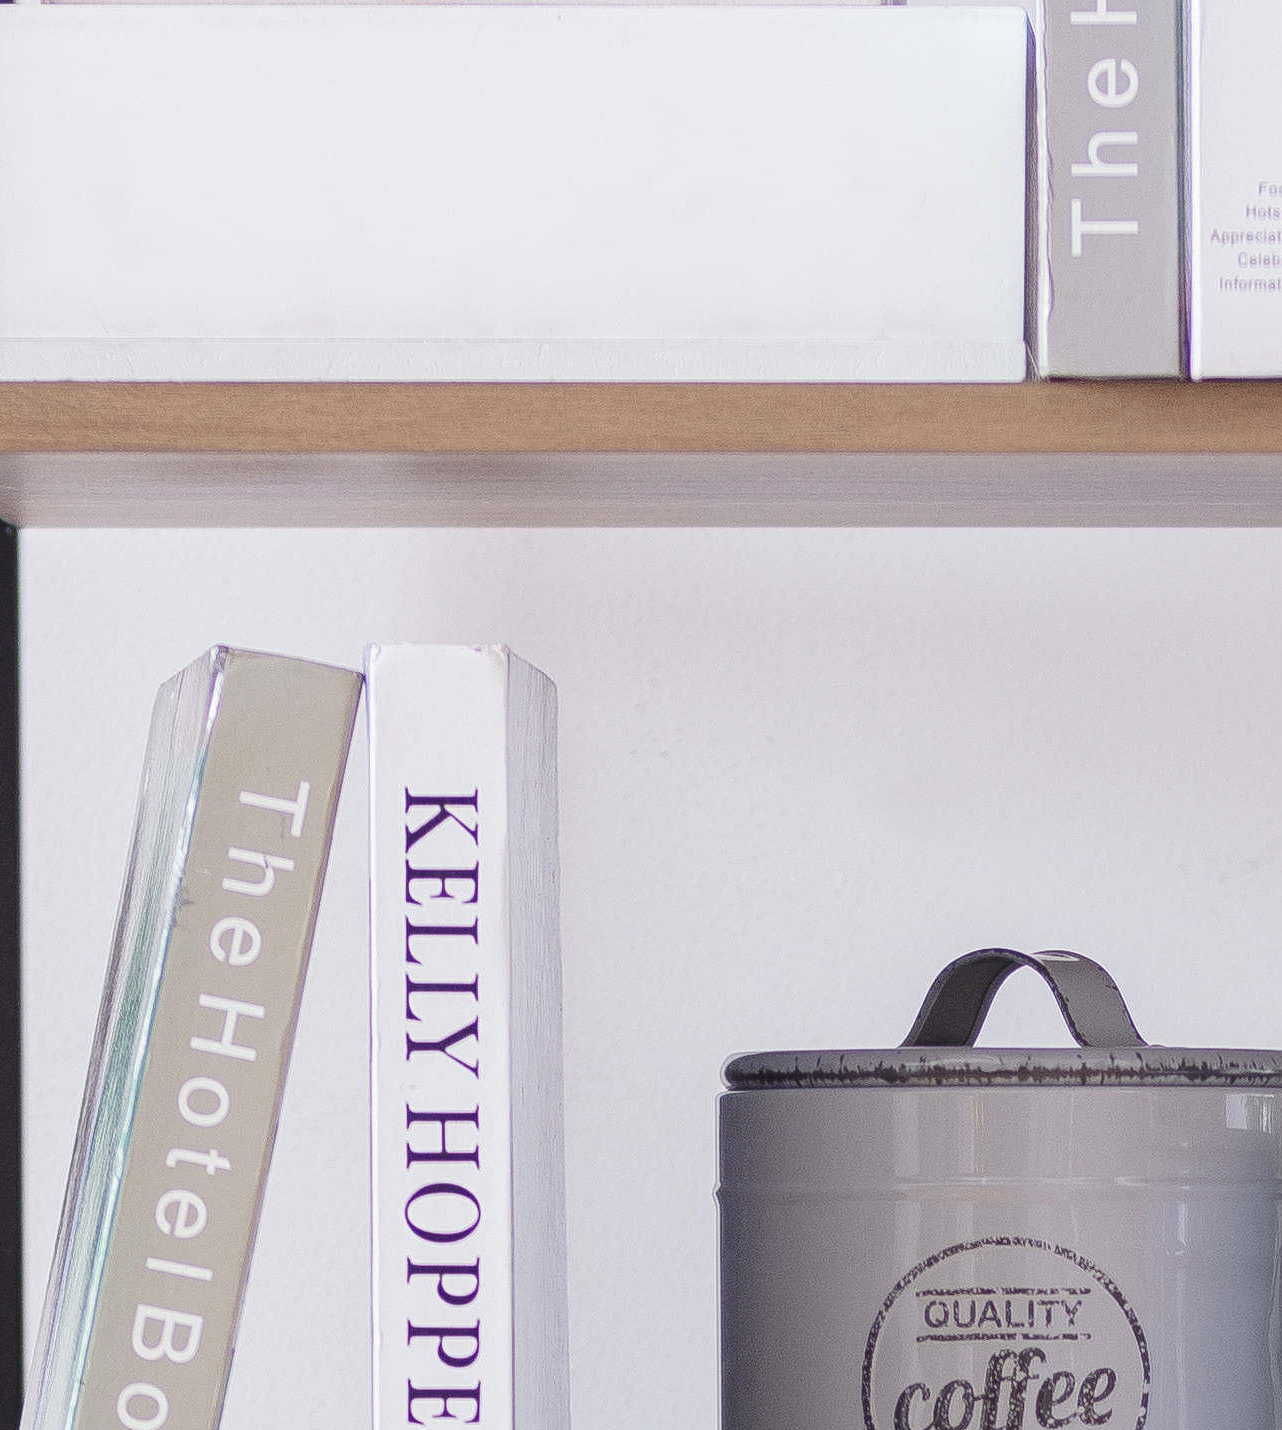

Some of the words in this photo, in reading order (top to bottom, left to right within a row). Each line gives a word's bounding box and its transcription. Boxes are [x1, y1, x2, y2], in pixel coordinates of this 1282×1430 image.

[1071, 58, 1139, 256] The
[208, 780, 311, 967] The
[404, 788, 479, 1077] KELLY
[918, 1298, 1088, 1332] QUALITY
